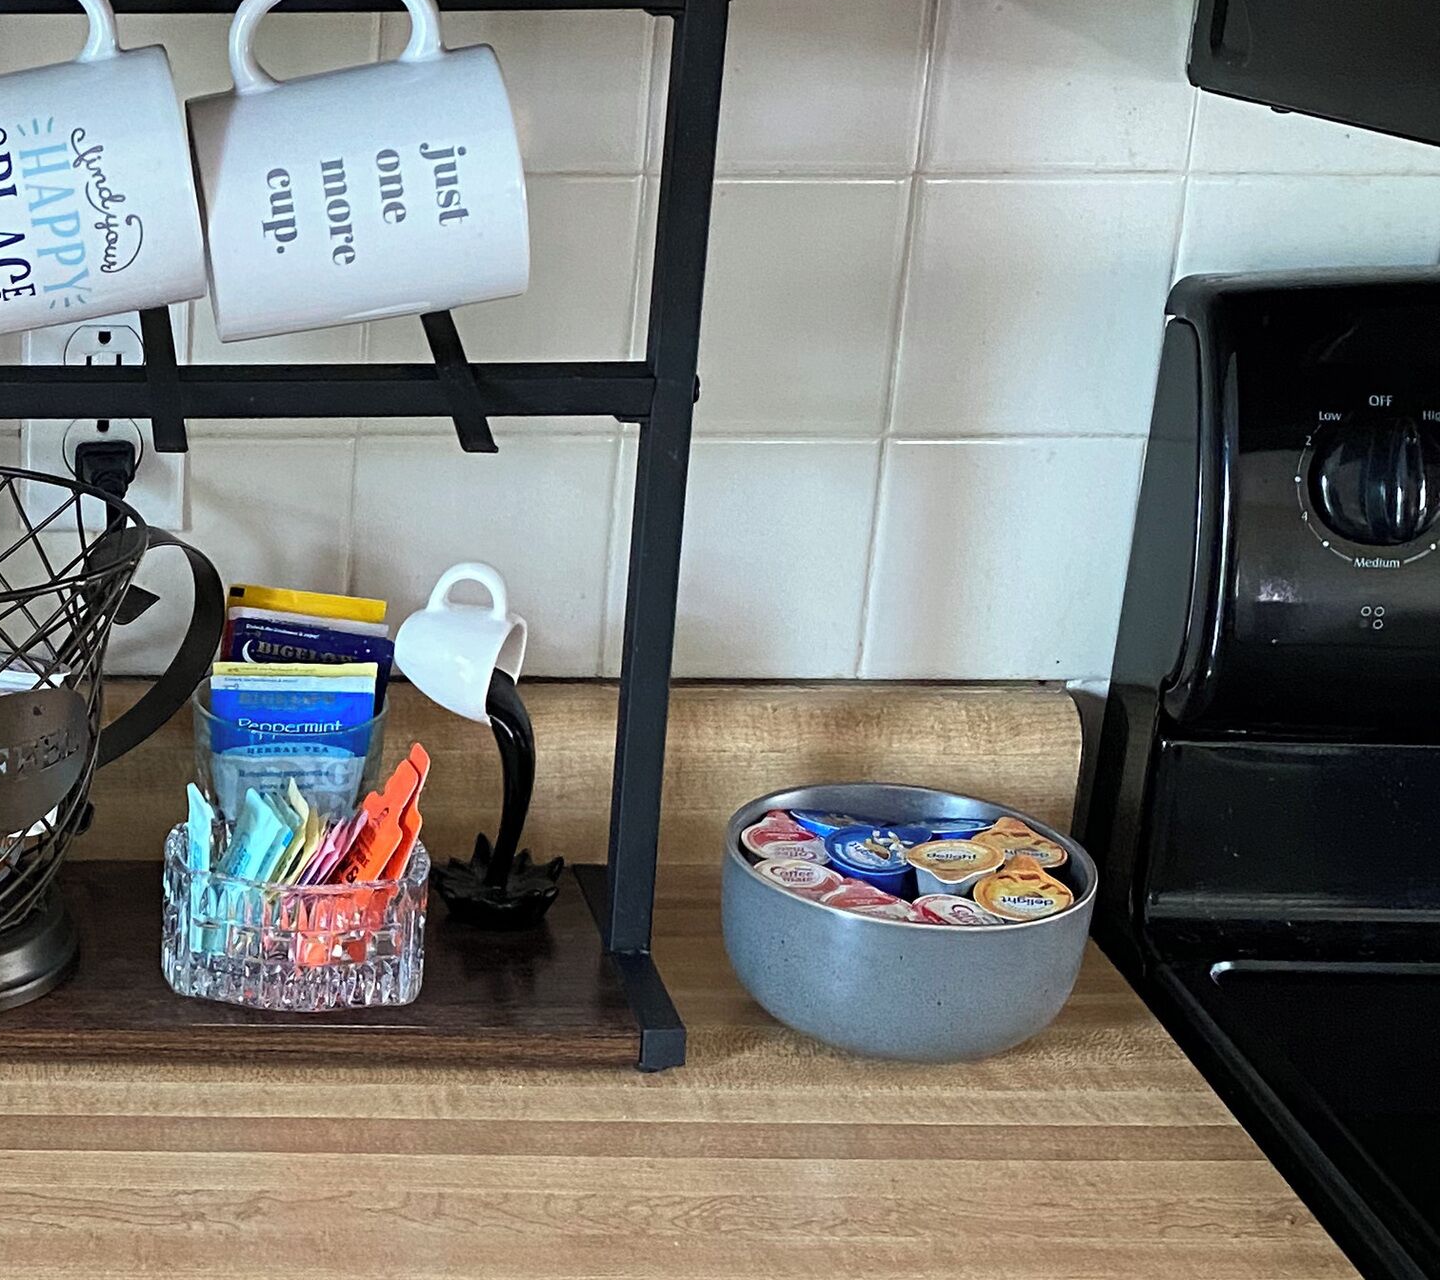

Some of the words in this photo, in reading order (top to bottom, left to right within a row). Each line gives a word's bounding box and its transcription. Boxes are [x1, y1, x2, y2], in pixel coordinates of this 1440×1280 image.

[71, 127, 126, 210] find
[376, 148, 407, 225] one
[419, 142, 469, 228] just
[19, 143, 92, 293] HAPPY
[261, 167, 298, 255] cup.
[320, 156, 356, 267] more
[86, 184, 144, 274] your
[1368, 394, 1393, 407] OFF
[1318, 410, 1342, 421] Low
[1305, 435, 1312, 446] 2
[1301, 511, 1308, 521] 4
[1353, 557, 1401, 569] Medium
[238, 717, 343, 741] Peppermint
[246, 747, 299, 755] HERBAL
[304, 746, 330, 754] TEA
[1001, 894, 1054, 907] delight
